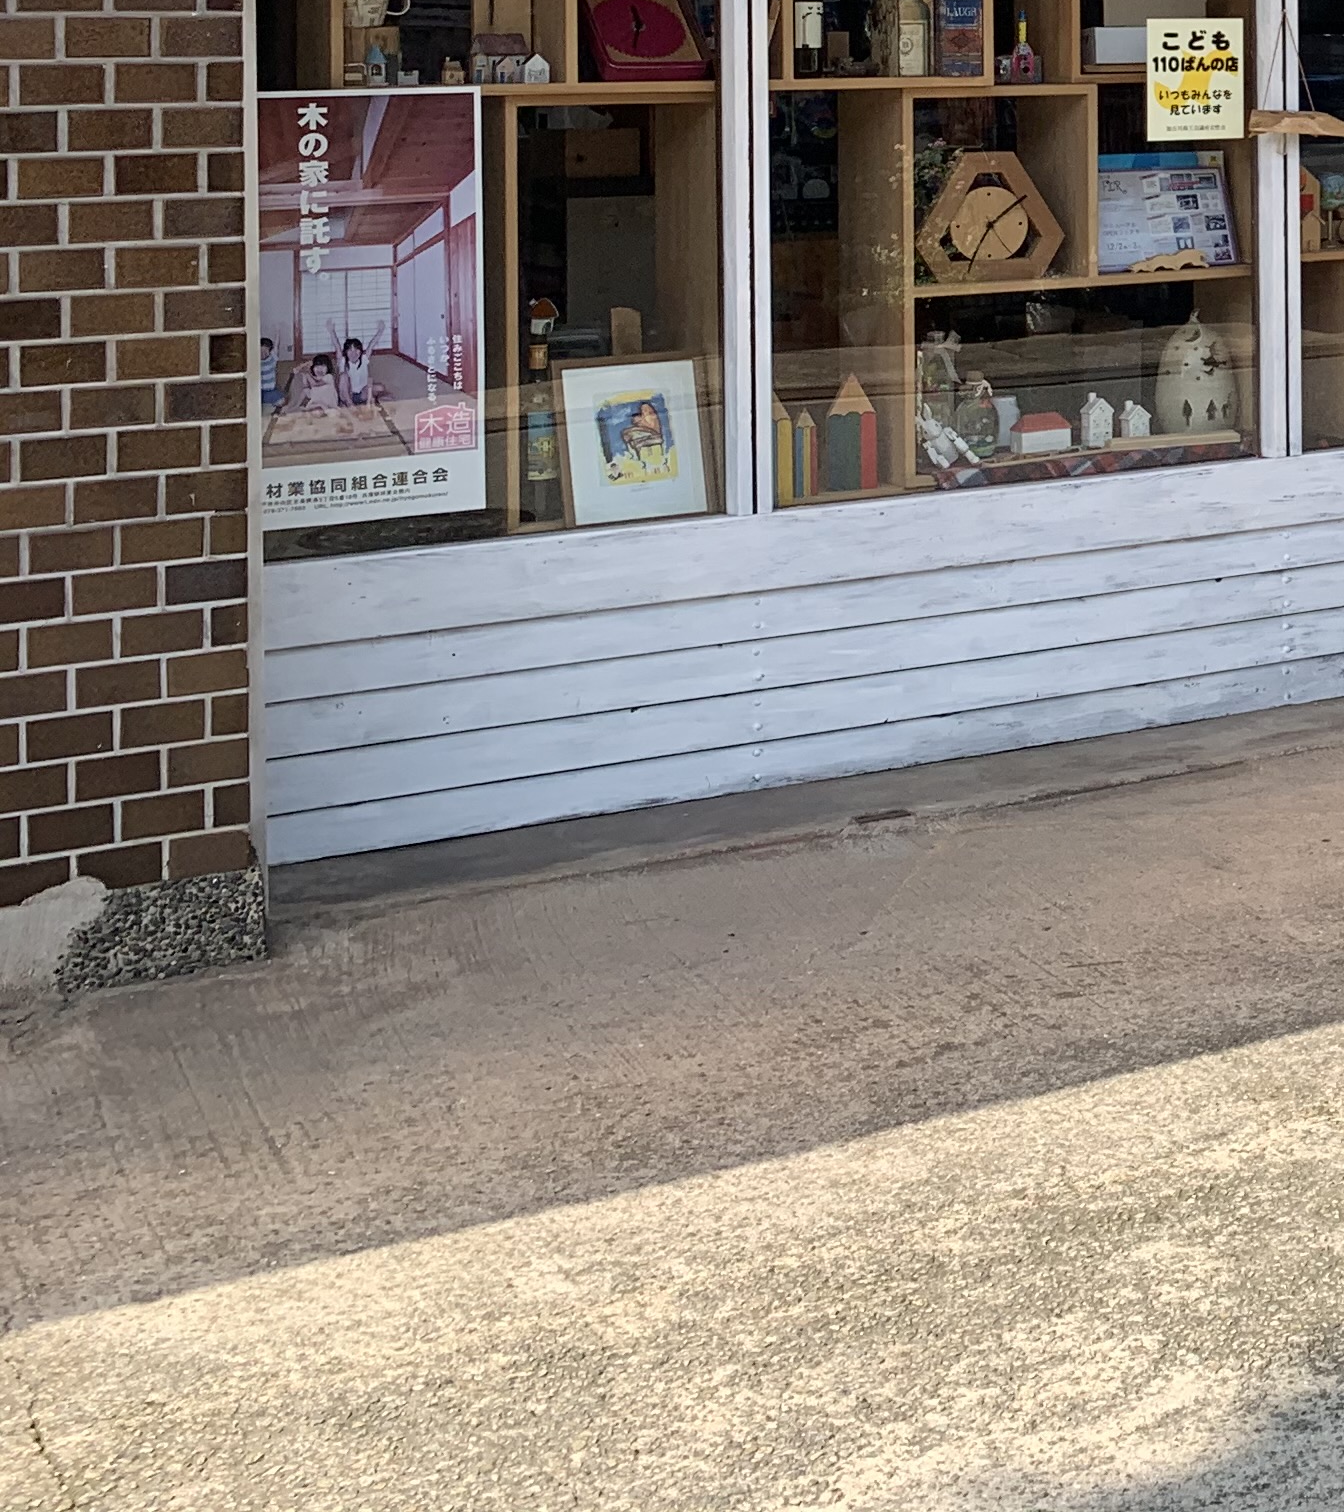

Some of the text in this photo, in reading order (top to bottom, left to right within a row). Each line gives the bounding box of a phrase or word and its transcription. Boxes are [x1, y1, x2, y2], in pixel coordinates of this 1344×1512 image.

[1162, 29, 1231, 51] こども
[1152, 56, 1239, 72] 110ばんの店
[1158, 90, 1233, 100] いつもみんなを
[1169, 104, 1223, 116] 見ています
[297, 102, 331, 281] 木の家に託す。
[418, 410, 472, 437] 木造
